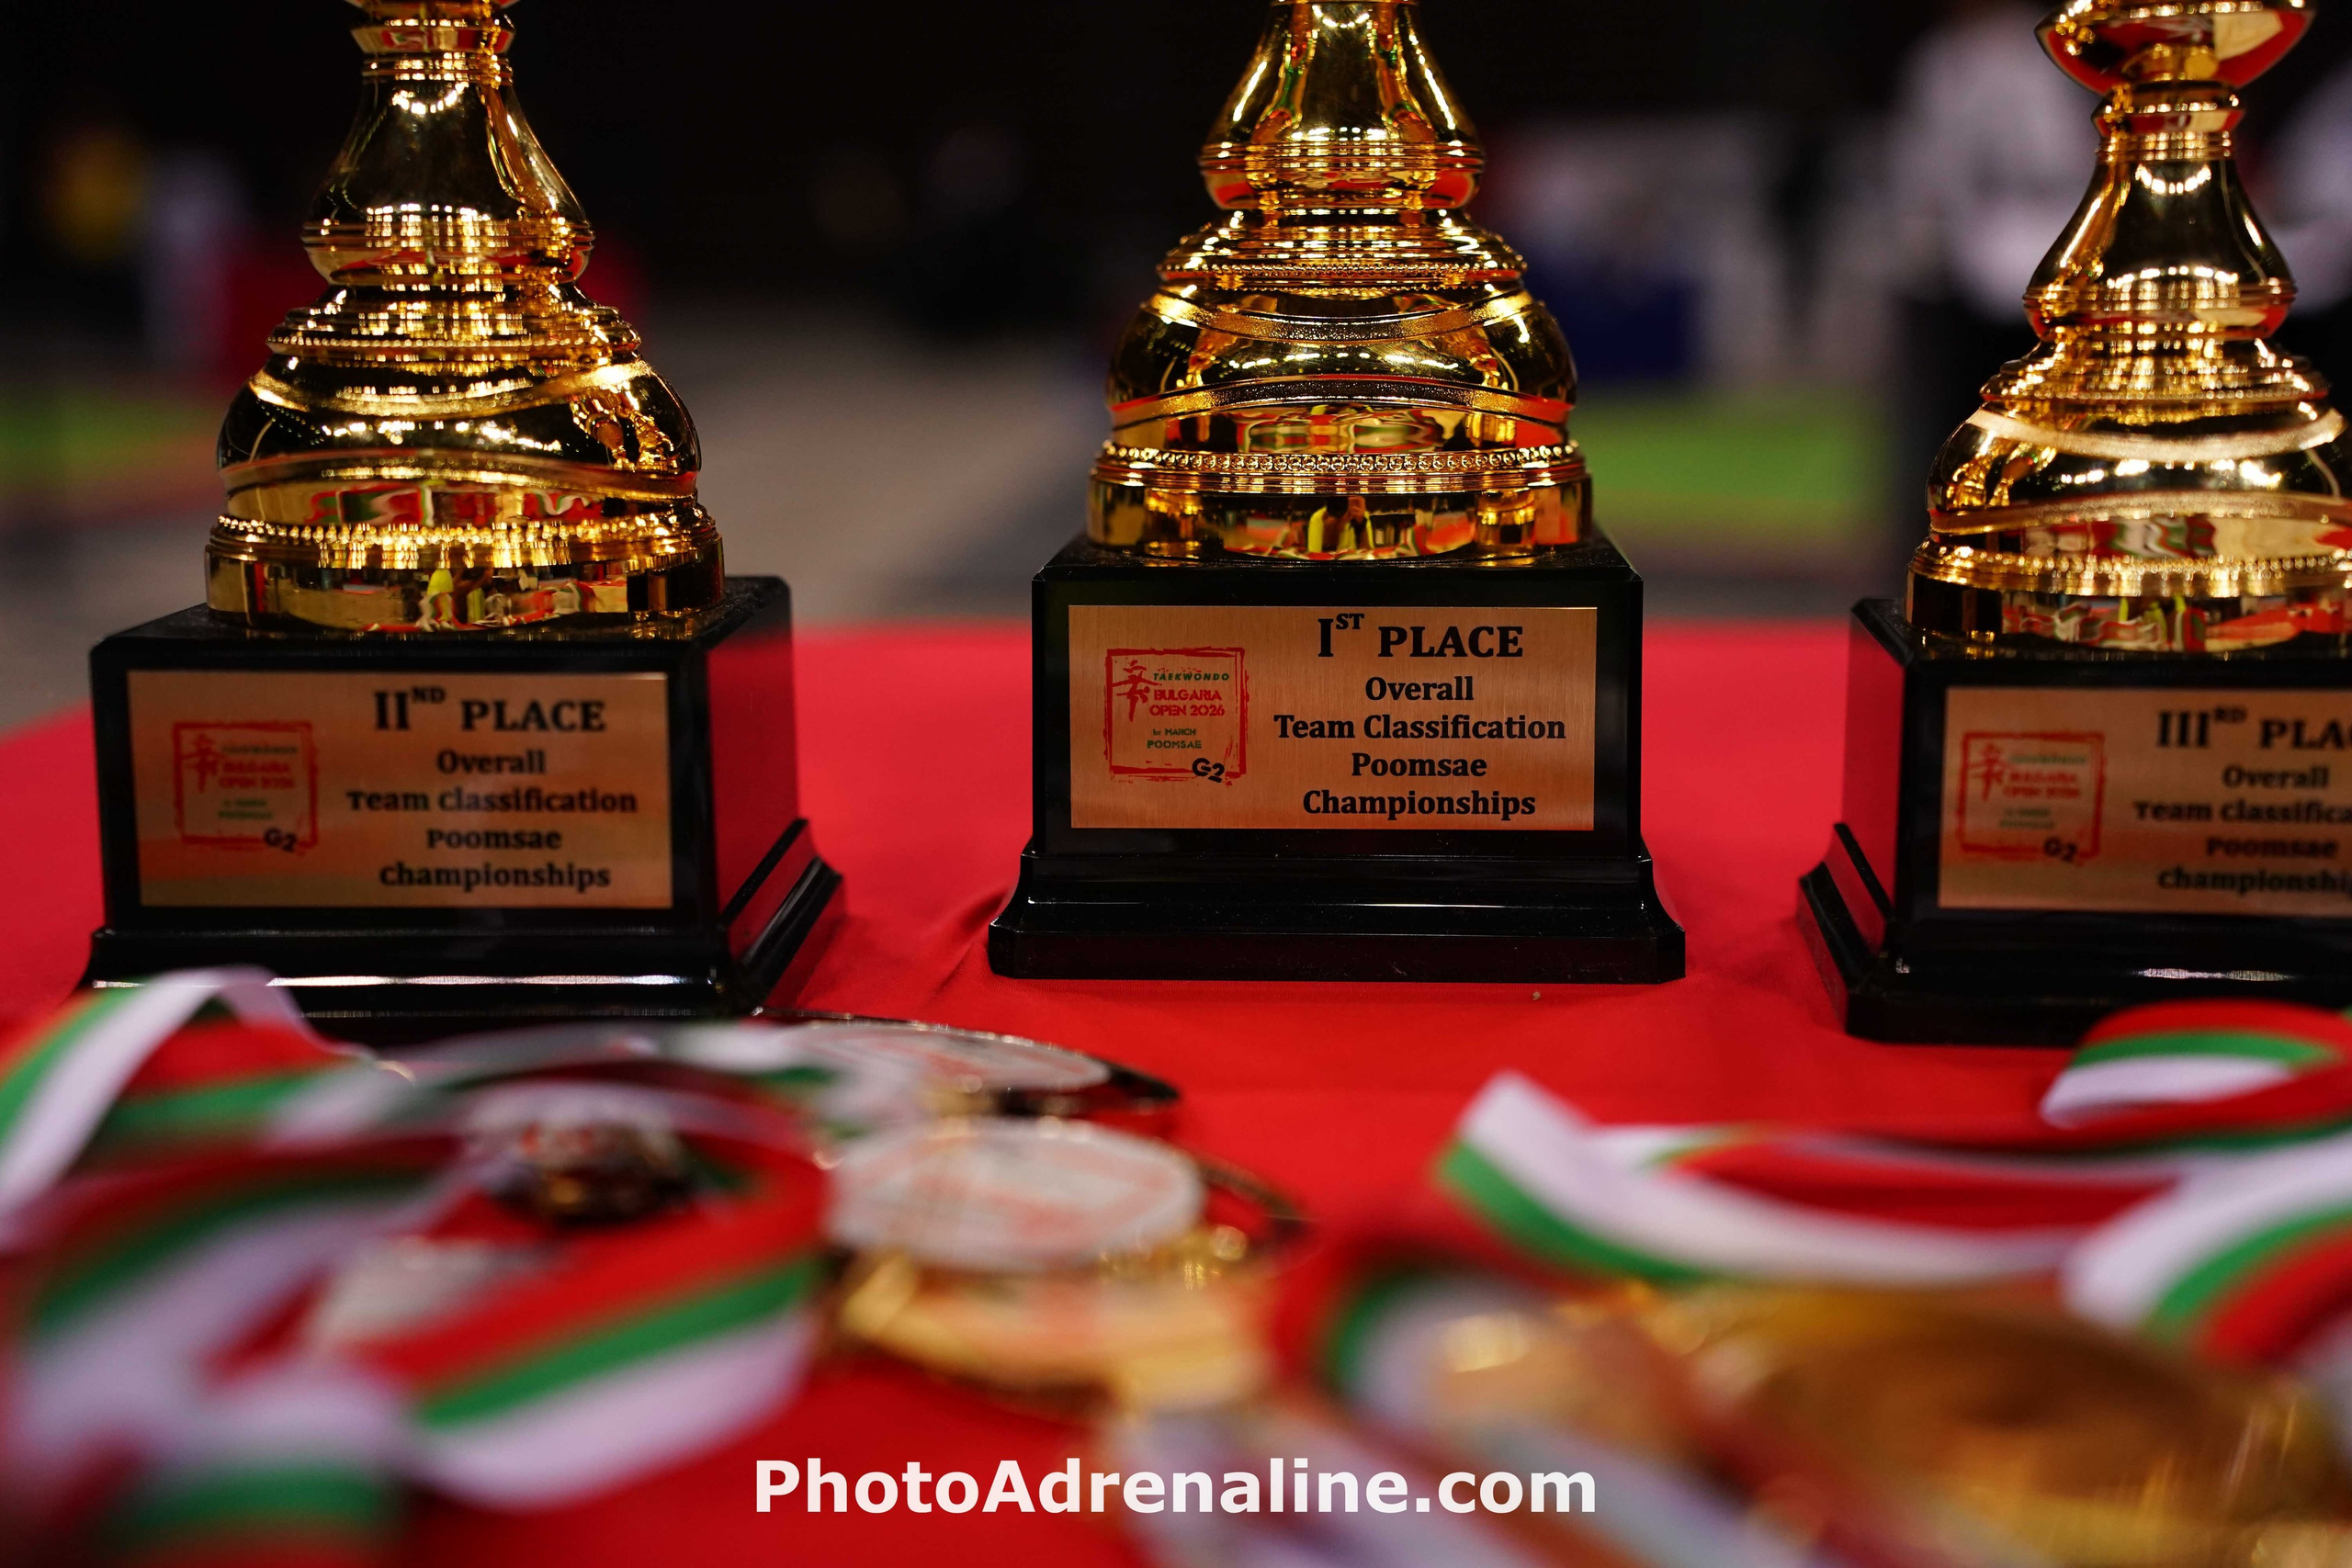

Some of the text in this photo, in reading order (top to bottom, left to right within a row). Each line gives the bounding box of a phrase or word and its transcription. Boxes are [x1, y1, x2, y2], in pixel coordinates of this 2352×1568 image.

[1377, 626, 1523, 658] PLACE
[1153, 672, 1230, 682] TAEKWONDO
[1364, 675, 1475, 701] Overall
[1153, 689, 1222, 701] BULGARIA
[461, 699, 606, 732] PLACE
[1148, 705, 1226, 716] OPEN 2026
[1164, 728, 1197, 736] MARCH
[1273, 714, 1566, 739] Team Classification
[2257, 718, 2352, 750] PLA
[1147, 739, 1203, 750] POOMSAE
[436, 749, 546, 774] Overall
[1192, 757, 1226, 784] G2
[1351, 752, 1487, 777] Poomsae
[2222, 764, 2331, 788] Overall
[345, 790, 430, 812] Team
[1303, 790, 1536, 821] Championships
[426, 829, 563, 850] Poomsae
